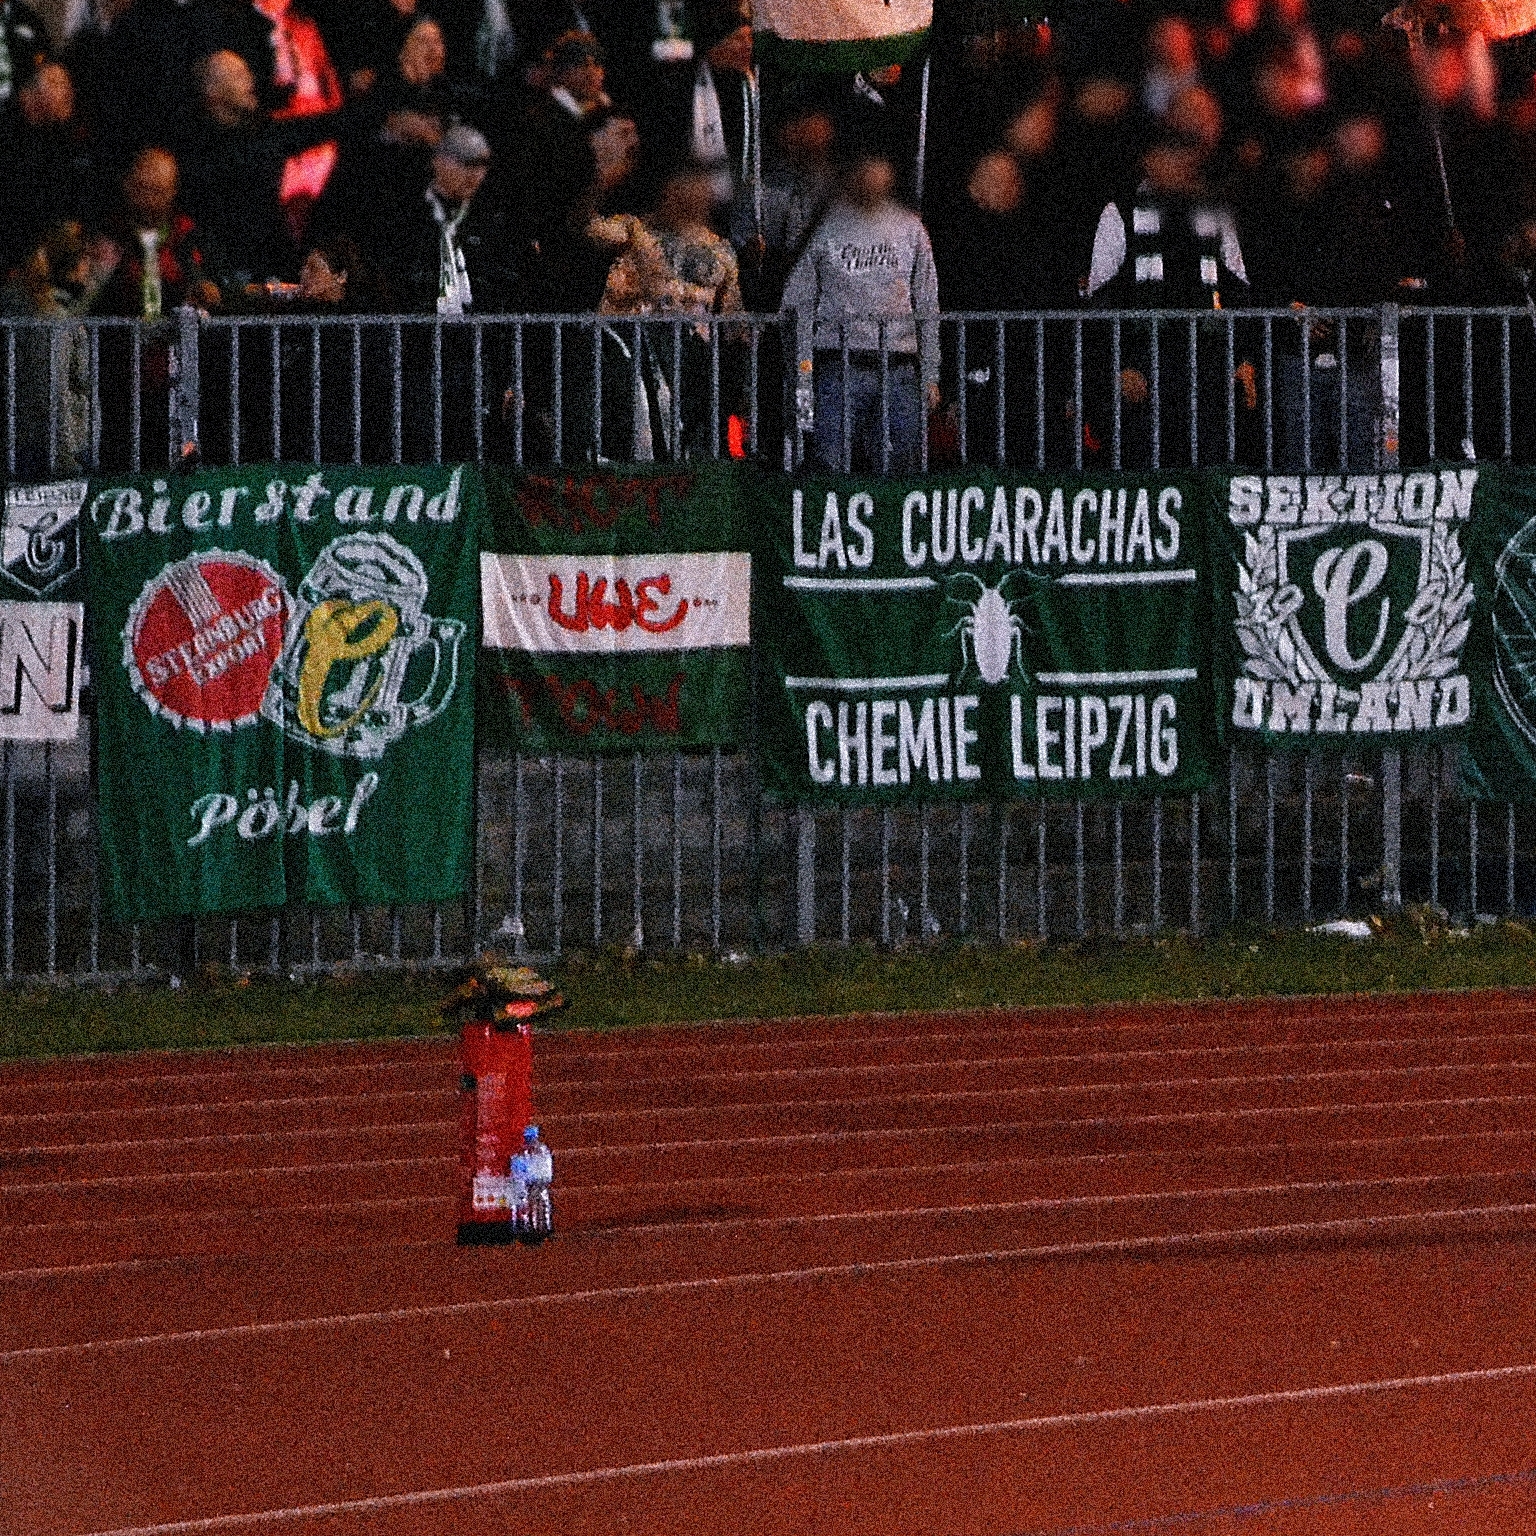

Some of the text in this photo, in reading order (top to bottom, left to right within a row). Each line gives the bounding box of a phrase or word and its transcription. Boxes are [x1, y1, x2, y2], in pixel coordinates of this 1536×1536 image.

[91, 465, 464, 540] Bierstand
[792, 486, 1183, 569] LAS CUCARACHAS
[1228, 468, 1479, 525] SEKTION
[549, 571, 688, 632] UWE
[805, 693, 1179, 786] CHEMIE LEIPZIG
[187, 771, 379, 846] Pöbel
